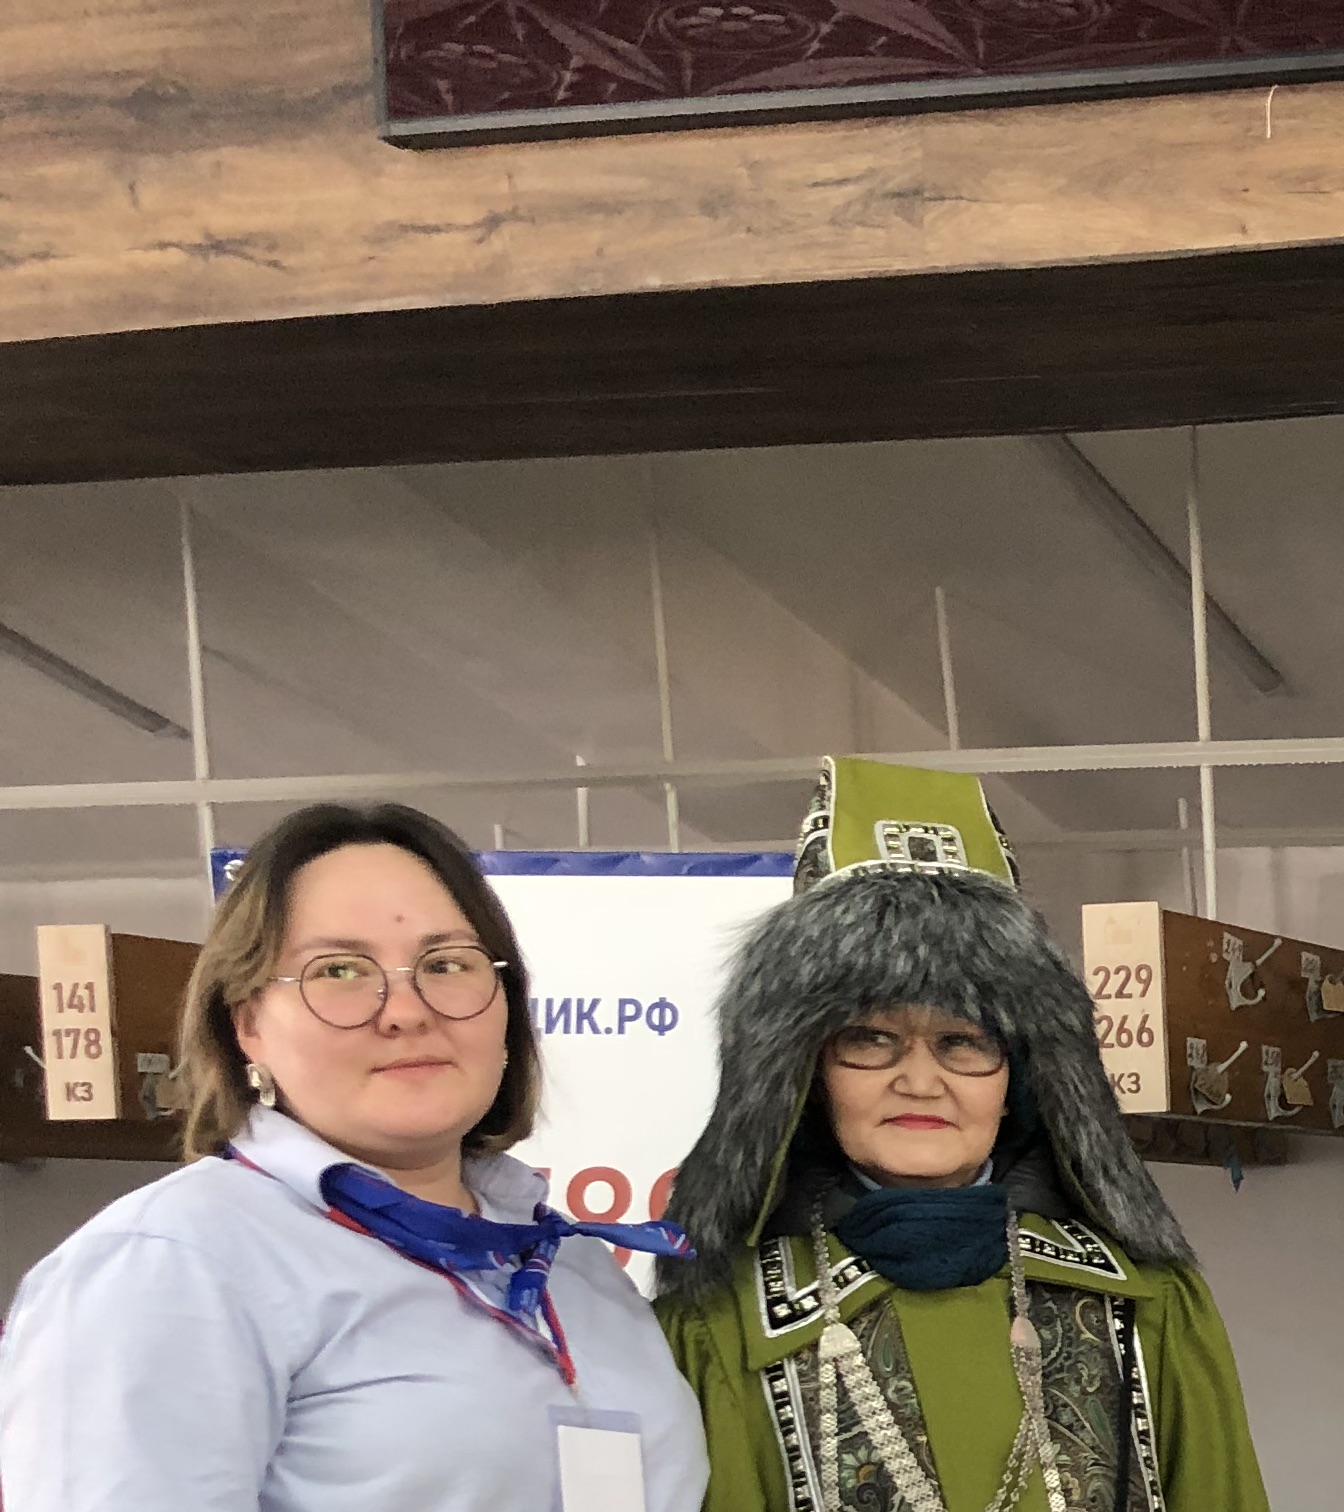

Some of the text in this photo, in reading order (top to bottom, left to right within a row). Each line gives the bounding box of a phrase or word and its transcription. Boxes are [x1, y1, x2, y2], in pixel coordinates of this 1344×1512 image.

[52, 981, 96, 1013] 141
[1092, 964, 1152, 999] 229
[52, 1027, 103, 1060] 178
[1094, 1014, 1154, 1048] 266
